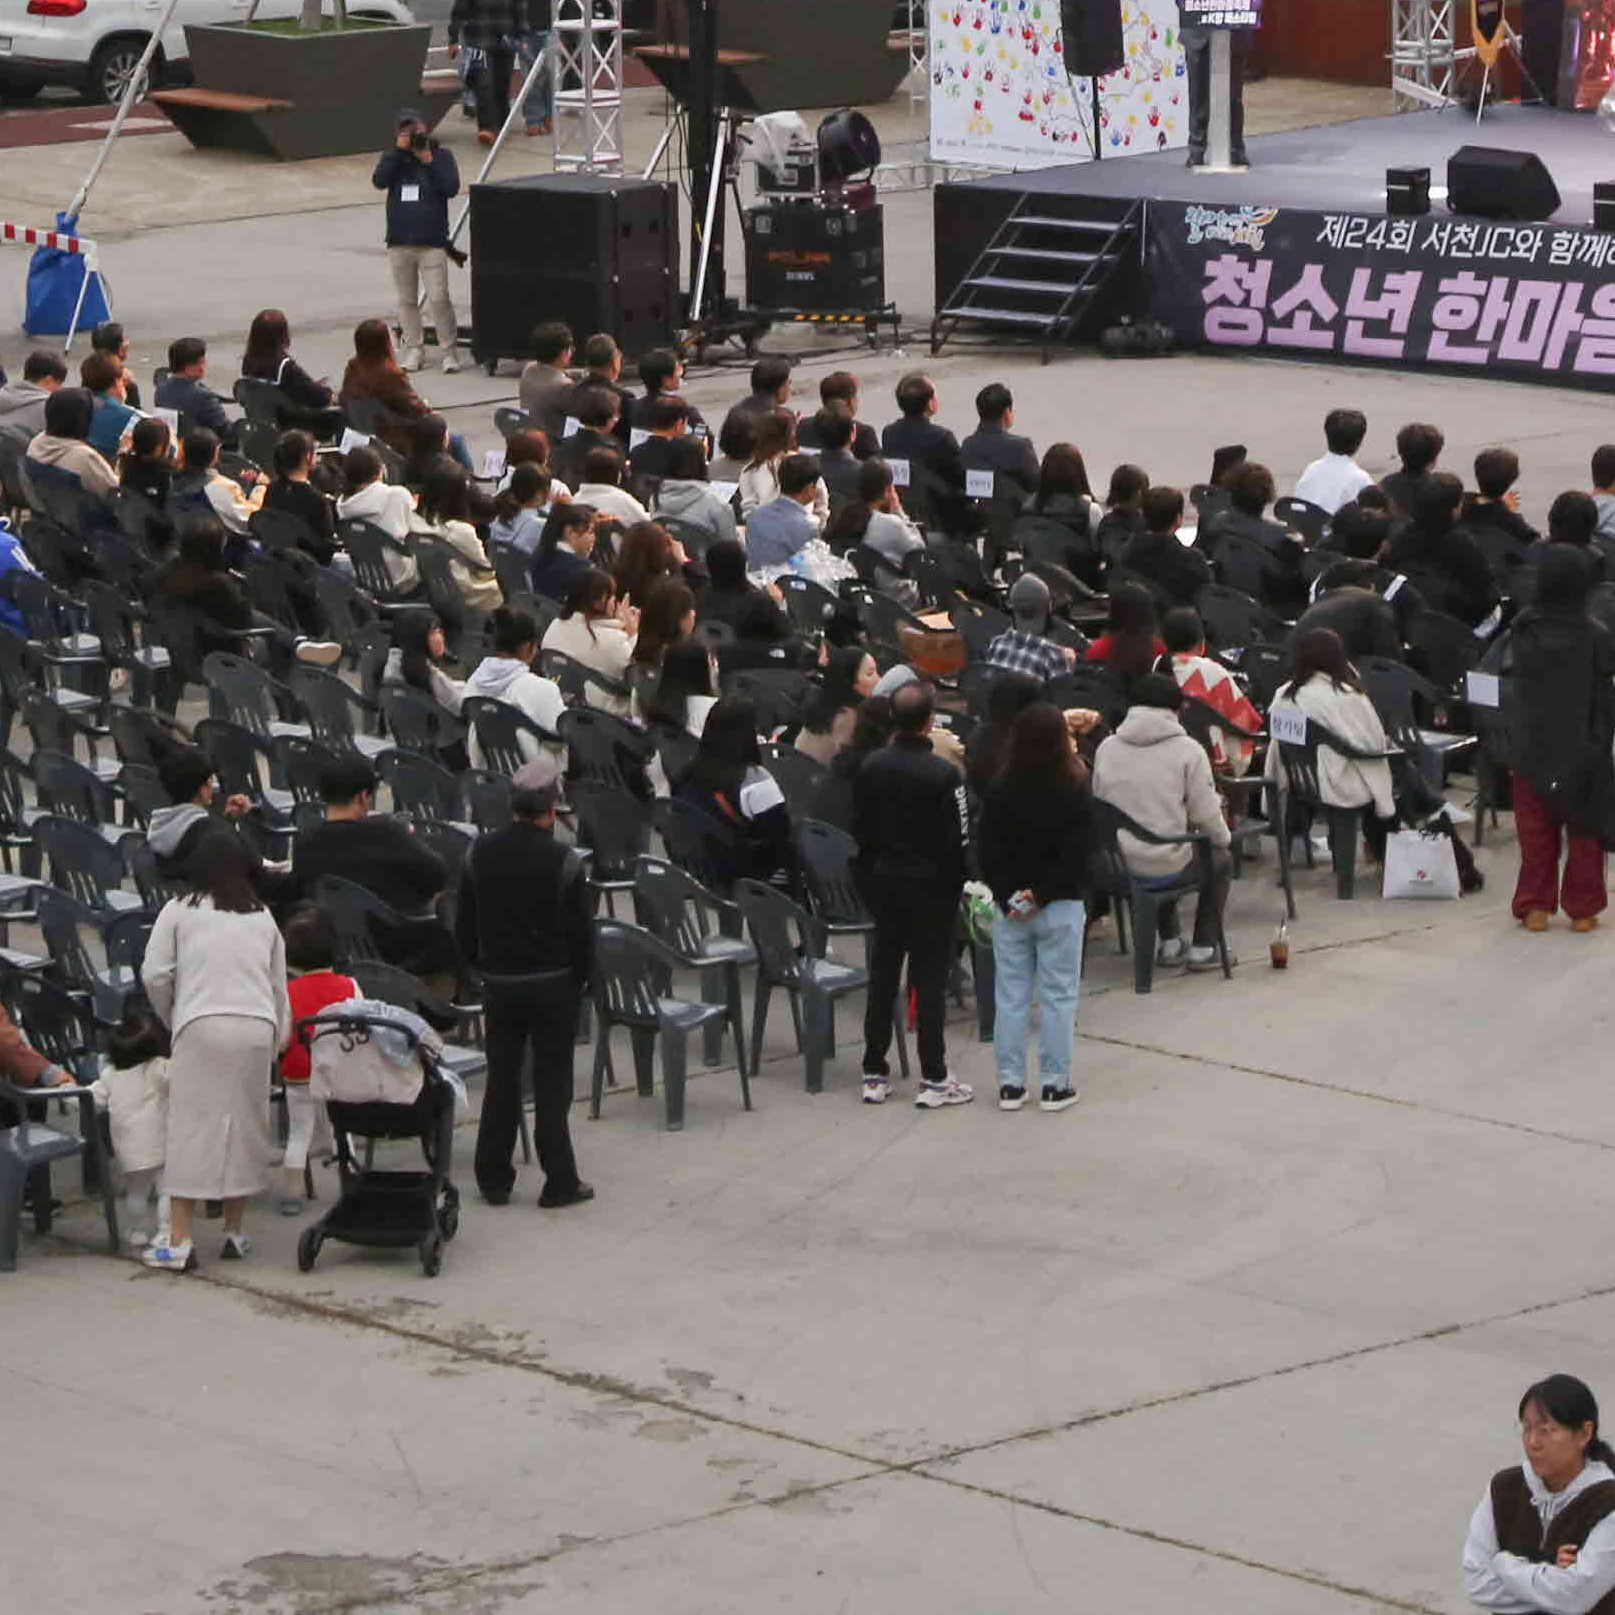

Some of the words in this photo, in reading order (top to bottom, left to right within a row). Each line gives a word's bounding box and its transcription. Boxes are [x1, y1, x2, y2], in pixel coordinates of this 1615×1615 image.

[1317, 215, 1417, 253] 제24회
[1421, 224, 1543, 263] 서천JC와
[1201, 253, 1422, 359] 청소년
